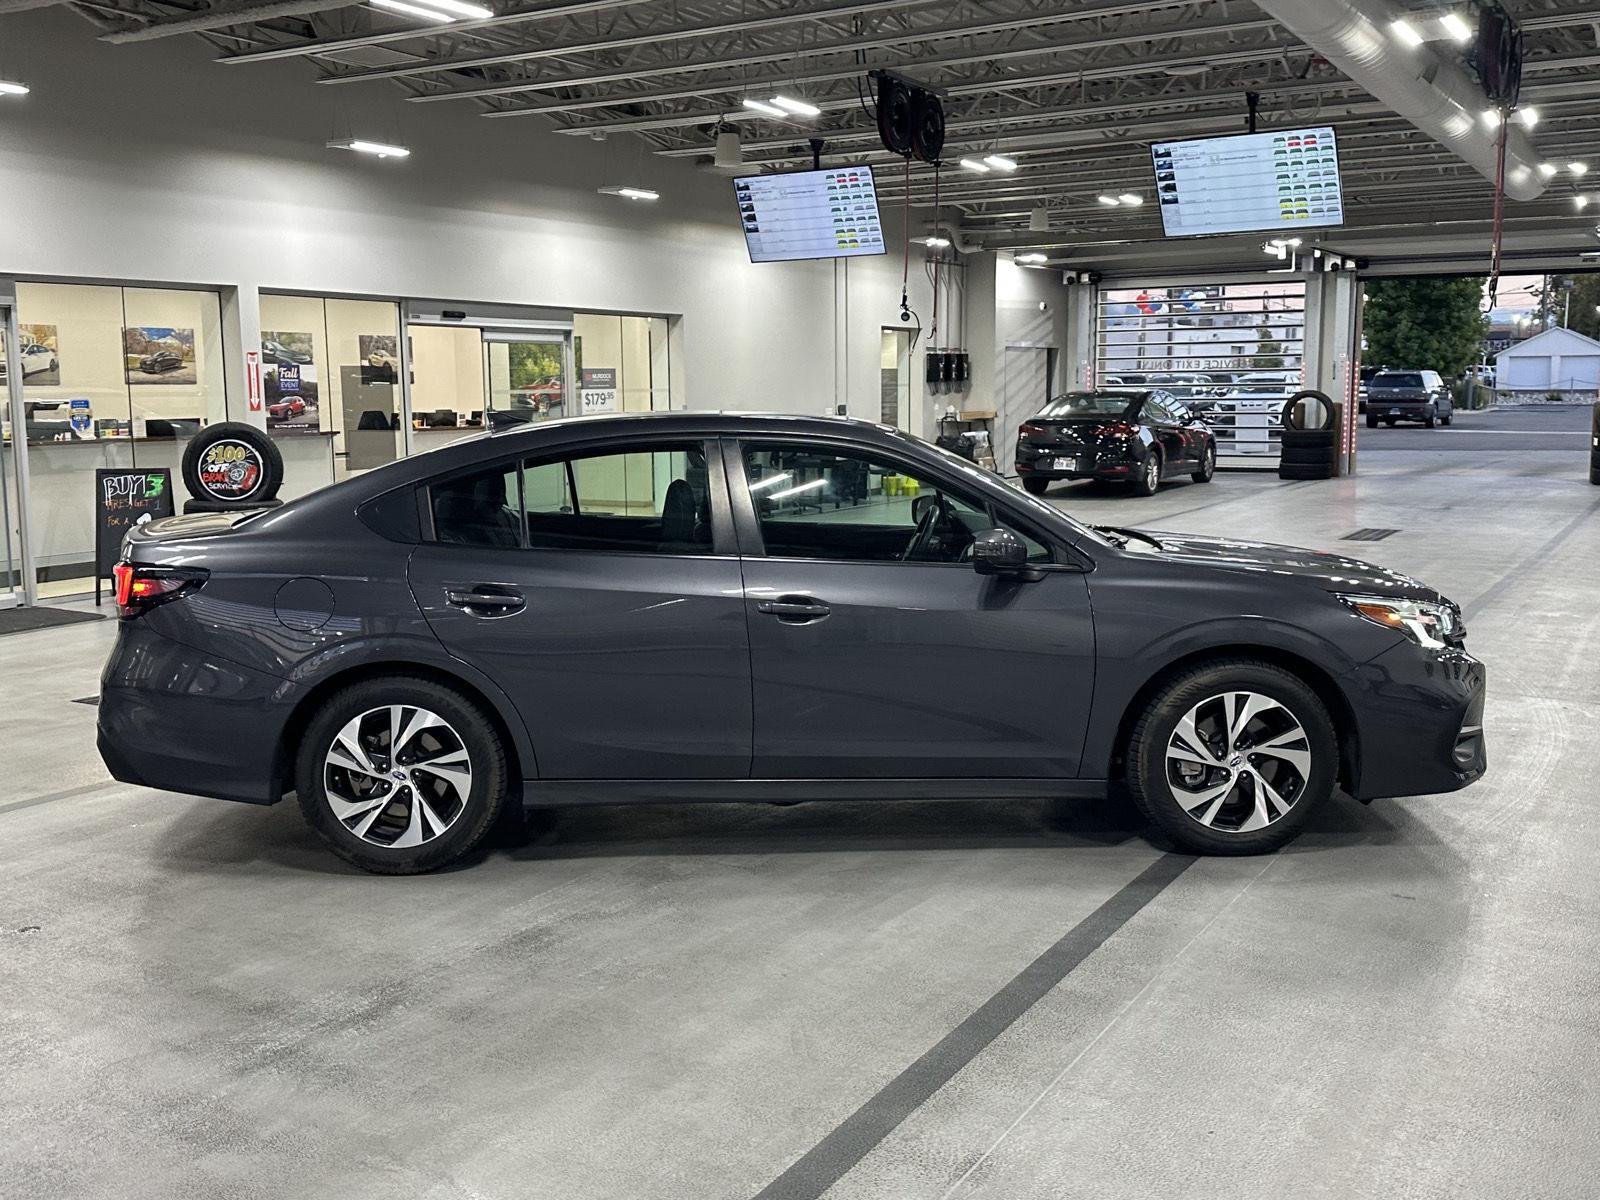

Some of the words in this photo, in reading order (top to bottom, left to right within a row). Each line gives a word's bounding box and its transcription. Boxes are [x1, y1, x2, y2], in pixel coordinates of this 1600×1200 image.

[279, 367, 298, 378] Fall
[206, 445, 246, 464] $100
[207, 463, 229, 473] OFF
[103, 475, 146, 500] BUY
[144, 473, 165, 498] 3
[133, 498, 153, 508] GET
